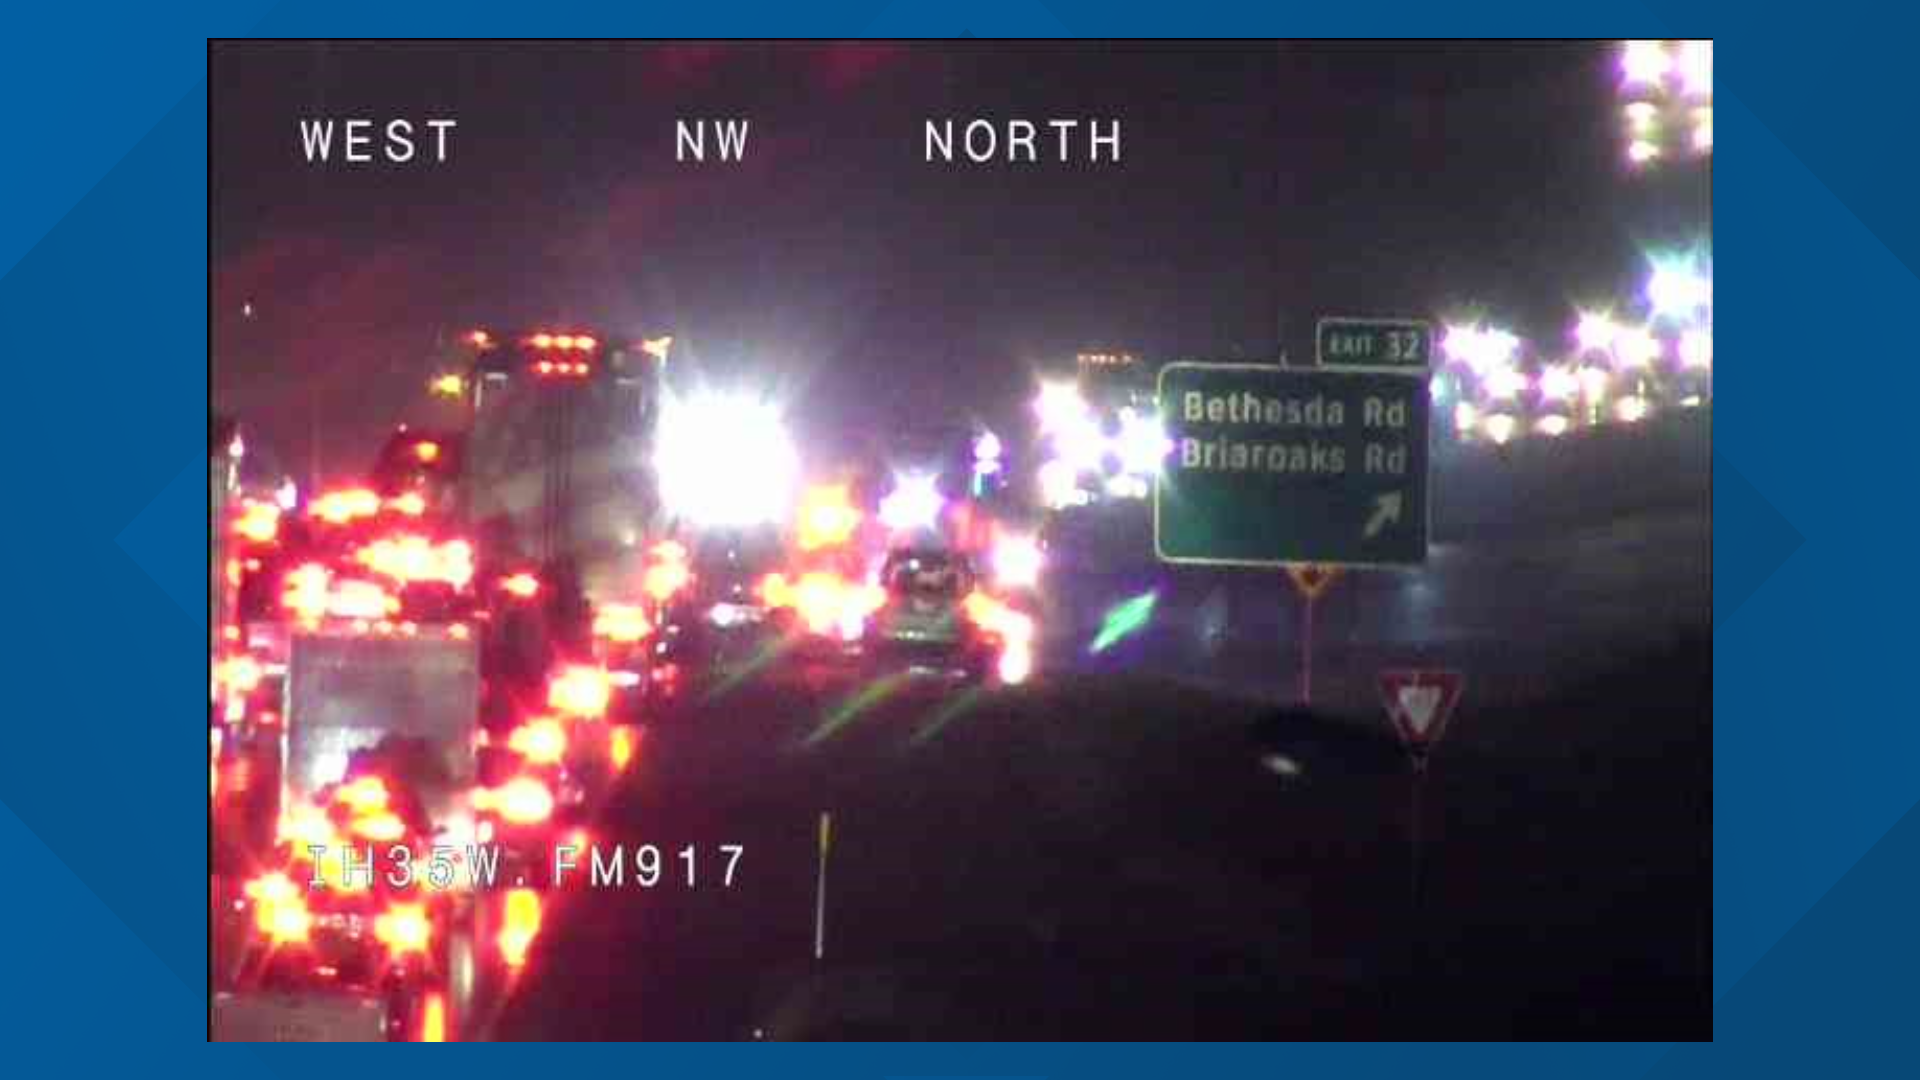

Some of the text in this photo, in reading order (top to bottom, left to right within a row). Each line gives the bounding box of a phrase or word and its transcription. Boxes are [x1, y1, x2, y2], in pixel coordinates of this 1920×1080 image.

[1329, 331, 1420, 360] EXIT 32
[1184, 391, 1405, 427] Bethesda Rd
[1182, 438, 1406, 474] Briaroaks Rd
